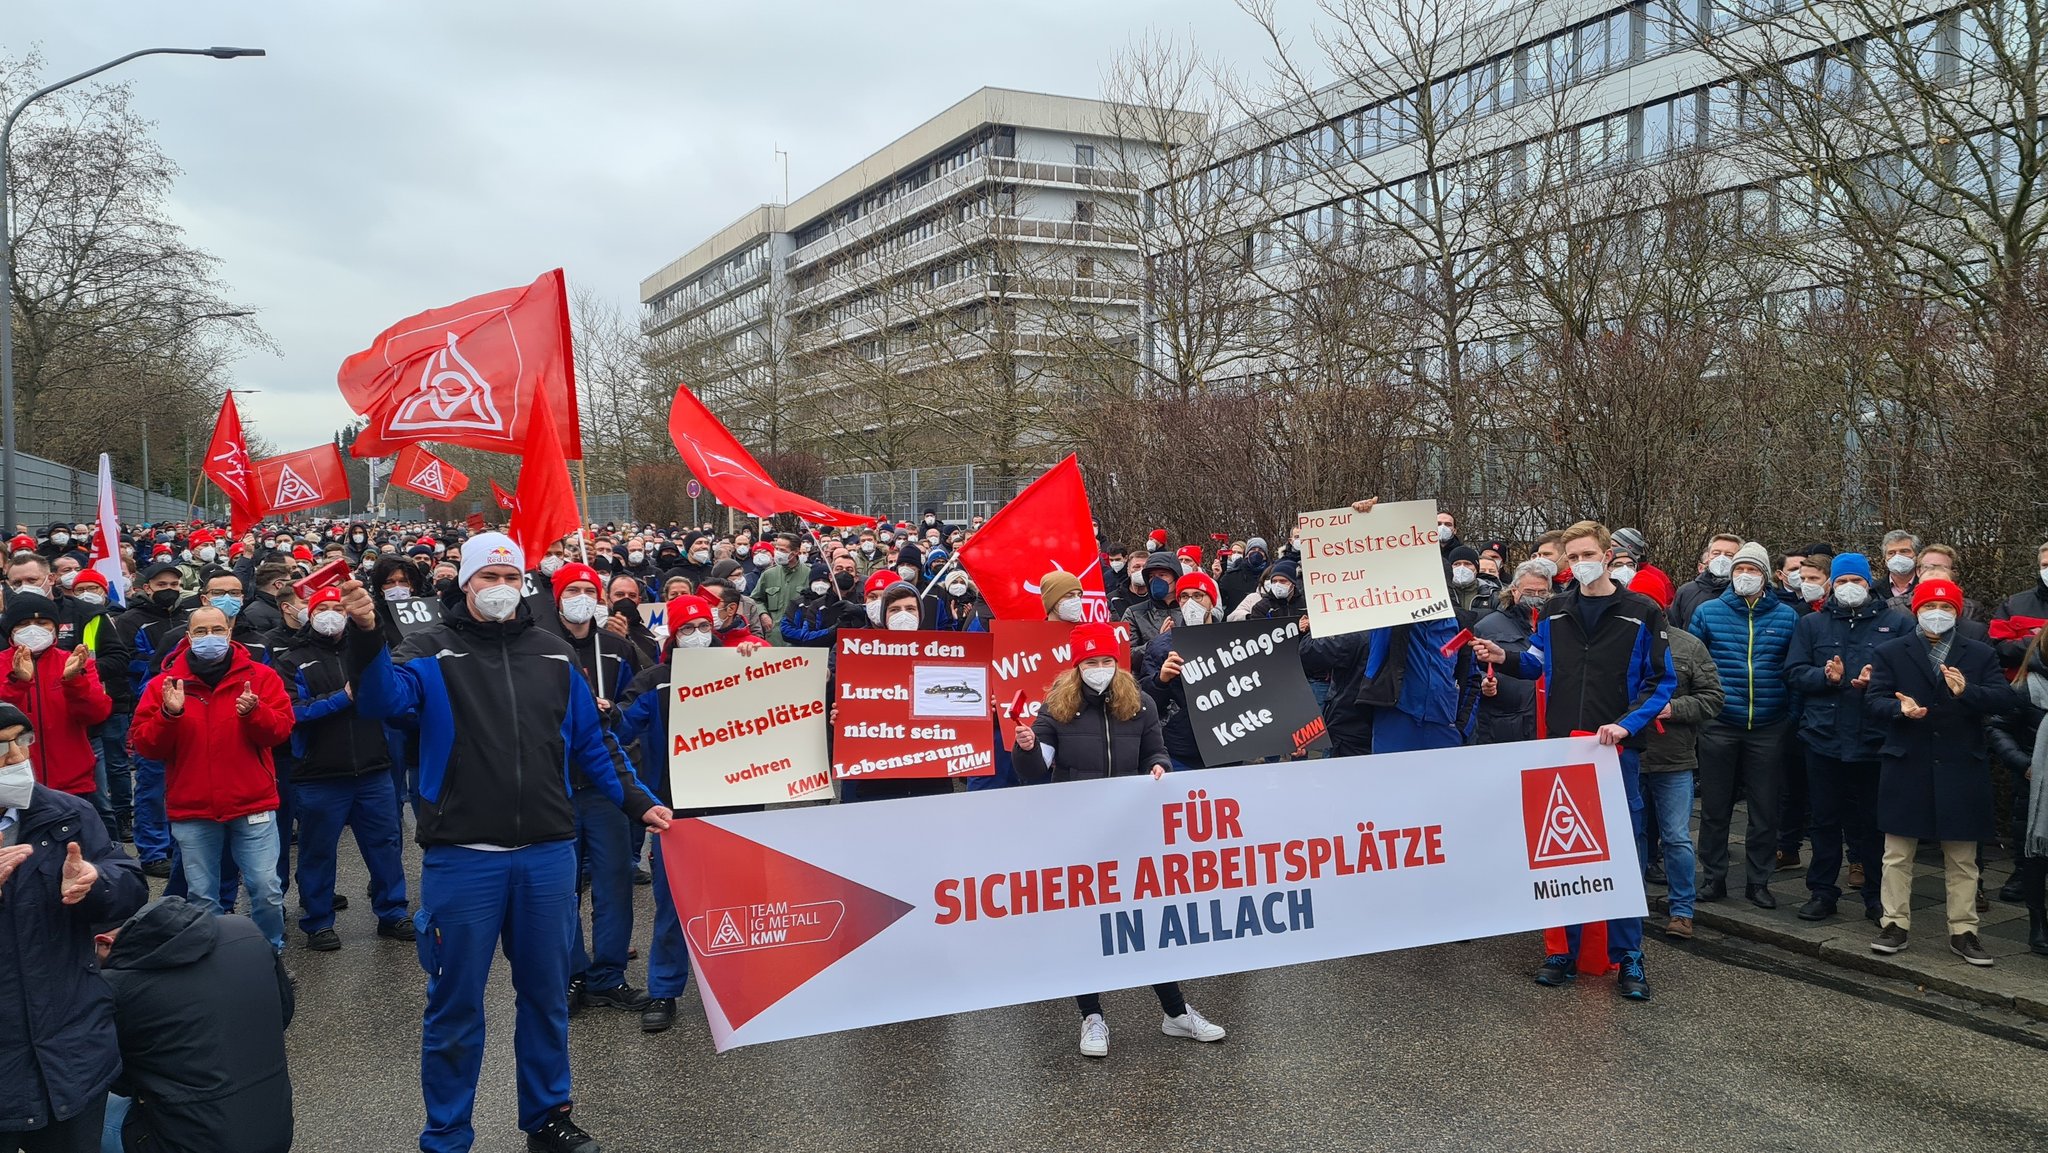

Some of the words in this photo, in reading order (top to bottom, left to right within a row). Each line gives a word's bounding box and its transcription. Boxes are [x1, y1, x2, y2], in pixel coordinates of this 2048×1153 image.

[1299, 516, 1325, 530] Pro
[1329, 513, 1353, 526] zur
[1300, 525, 1439, 560] Teststrecke
[487, 556, 502, 564] Red
[1310, 571, 1337, 585] Pro
[1341, 568, 1366, 582] zur
[395, 601, 432, 625] 58
[1312, 585, 1432, 614] Tradition
[1410, 599, 1449, 620] KMW
[841, 638, 919, 656] Nehmt
[924, 641, 966, 657] den
[1180, 655, 1218, 685] Wir
[1216, 622, 1299, 669] hängen
[678, 674, 741, 702] Panzer
[745, 655, 809, 681] fahren,
[991, 651, 1042, 681] Wir
[841, 683, 909, 700] Lurch
[1195, 689, 1225, 712] an
[1226, 670, 1262, 698] der
[673, 700, 824, 756] Arbeitsplätze
[843, 722, 906, 739] nicht
[910, 724, 956, 740] sein
[1211, 708, 1274, 747] Kette
[1291, 715, 1325, 748] KMW
[724, 757, 792, 784] wahren
[833, 742, 975, 778] Lebensraum
[947, 750, 991, 773] KMW
[787, 770, 829, 797] KMW
[1161, 788, 1244, 846] FÜR
[934, 859, 1121, 925] SICHERE
[1133, 821, 1446, 901] ARBEITSPLÄTZE
[1533, 875, 1614, 900] München
[750, 901, 788, 917] TEAM
[751, 918, 764, 931] IG
[769, 911, 821, 929] METALL
[1099, 909, 1146, 957] IN
[1157, 888, 1314, 949] ALLACH
[751, 929, 788, 946] KMW
